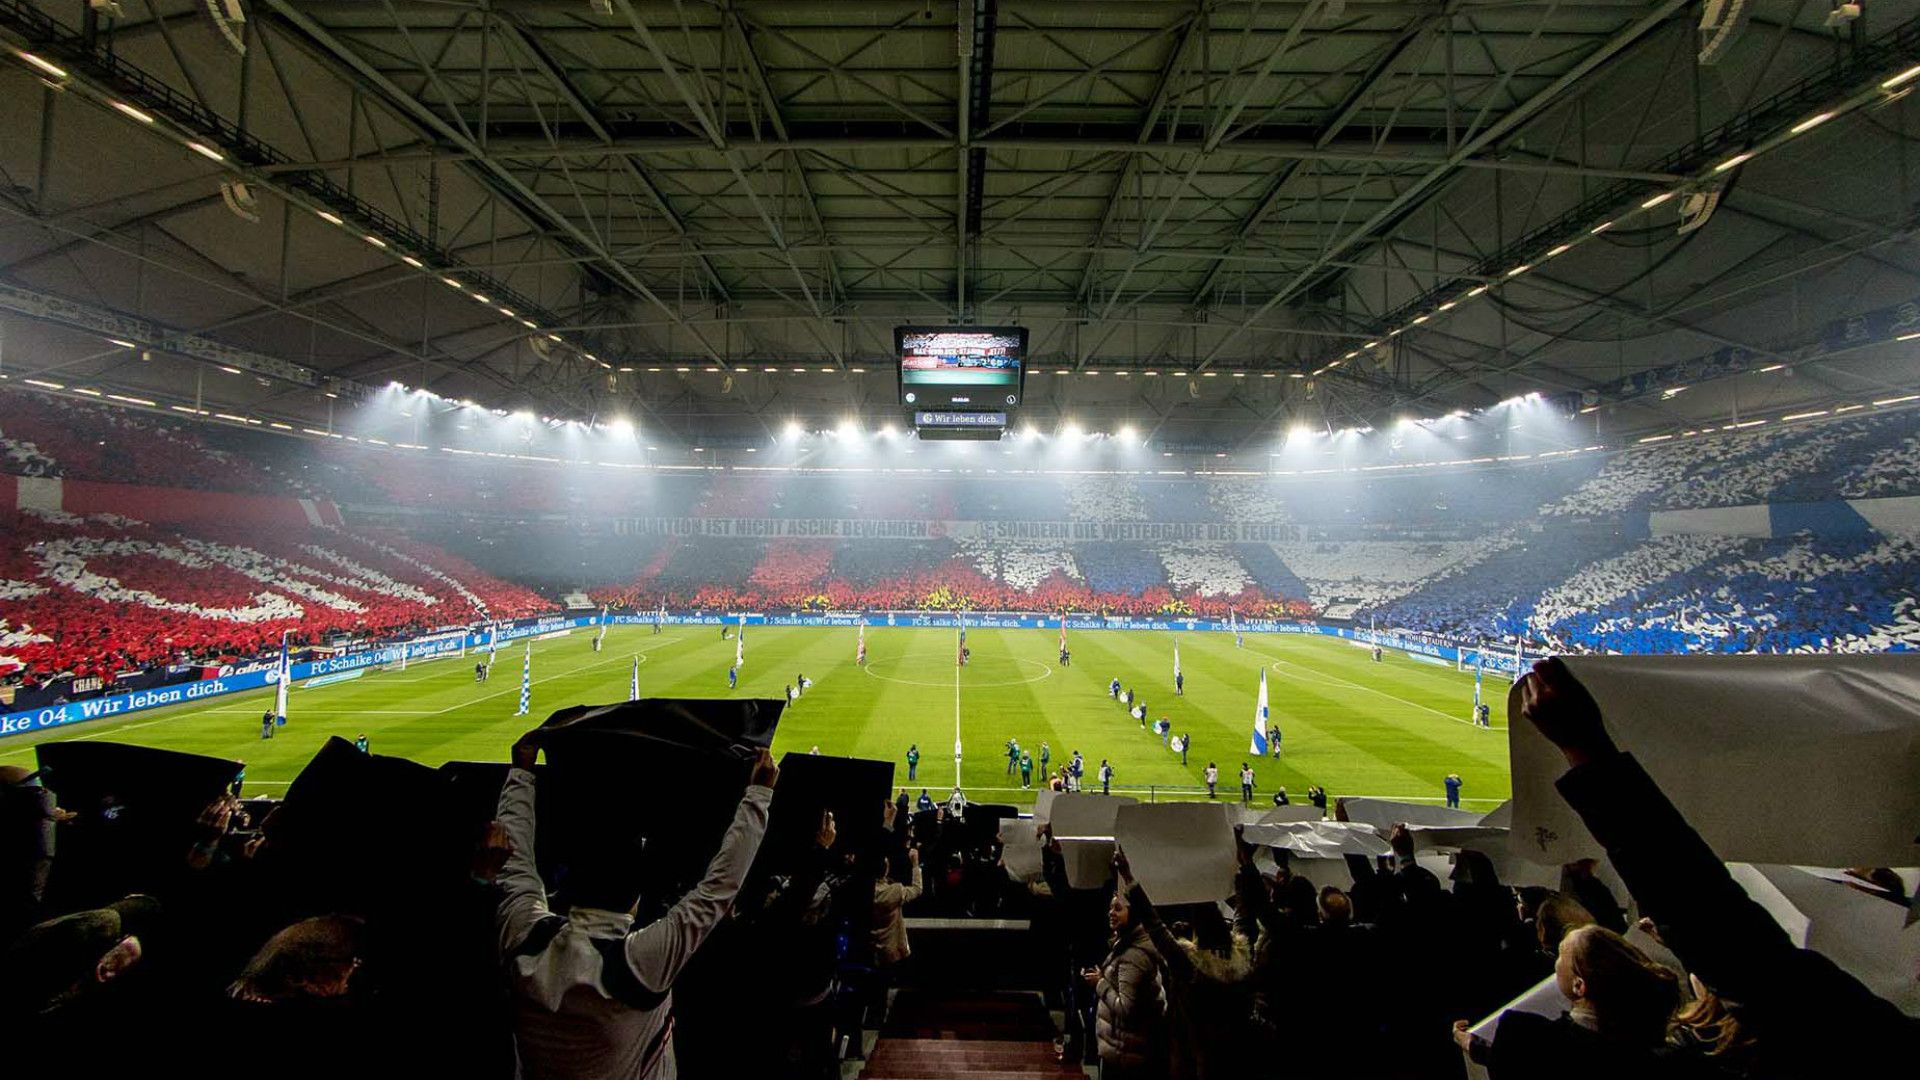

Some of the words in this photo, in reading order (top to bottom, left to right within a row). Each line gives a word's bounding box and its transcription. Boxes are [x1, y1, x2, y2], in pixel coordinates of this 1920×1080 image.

[935, 414, 949, 423] Wir
[952, 414, 976, 423] leben
[978, 414, 999, 423] dich.
[706, 519, 732, 536] IST
[735, 519, 782, 536] NICHT
[786, 519, 839, 536] ASCHE
[997, 521, 1071, 539] SONDERN
[1073, 522, 1099, 540] DIE
[1102, 523, 1202, 541] WEITERGABE
[1207, 524, 1238, 541] DES
[1240, 525, 1301, 542] FEUERS
[626, 615, 656, 624] Schalke
[668, 616, 681, 624] Wir
[683, 616, 703, 624] leben
[704, 616, 723, 625] dich.
[775, 616, 802, 625] Schalke
[816, 617, 829, 625] Wir
[832, 617, 851, 625] leben
[965, 619, 979, 627] Wir
[981, 619, 1001, 627] leben
[1002, 619, 1022, 627] dich.
[1072, 621, 1100, 629] Schalke
[1115, 621, 1129, 629] Wir
[1130, 621, 1150, 629] leben
[1152, 621, 1171, 630] dich.
[1280, 624, 1300, 632] leben
[311, 662, 327, 675] FC
[329, 655, 372, 672] Schalke
[39, 707, 74, 725] 04.
[82, 701, 123, 718] Wir
[128, 690, 181, 709] leben
[186, 680, 229, 697] dich.
